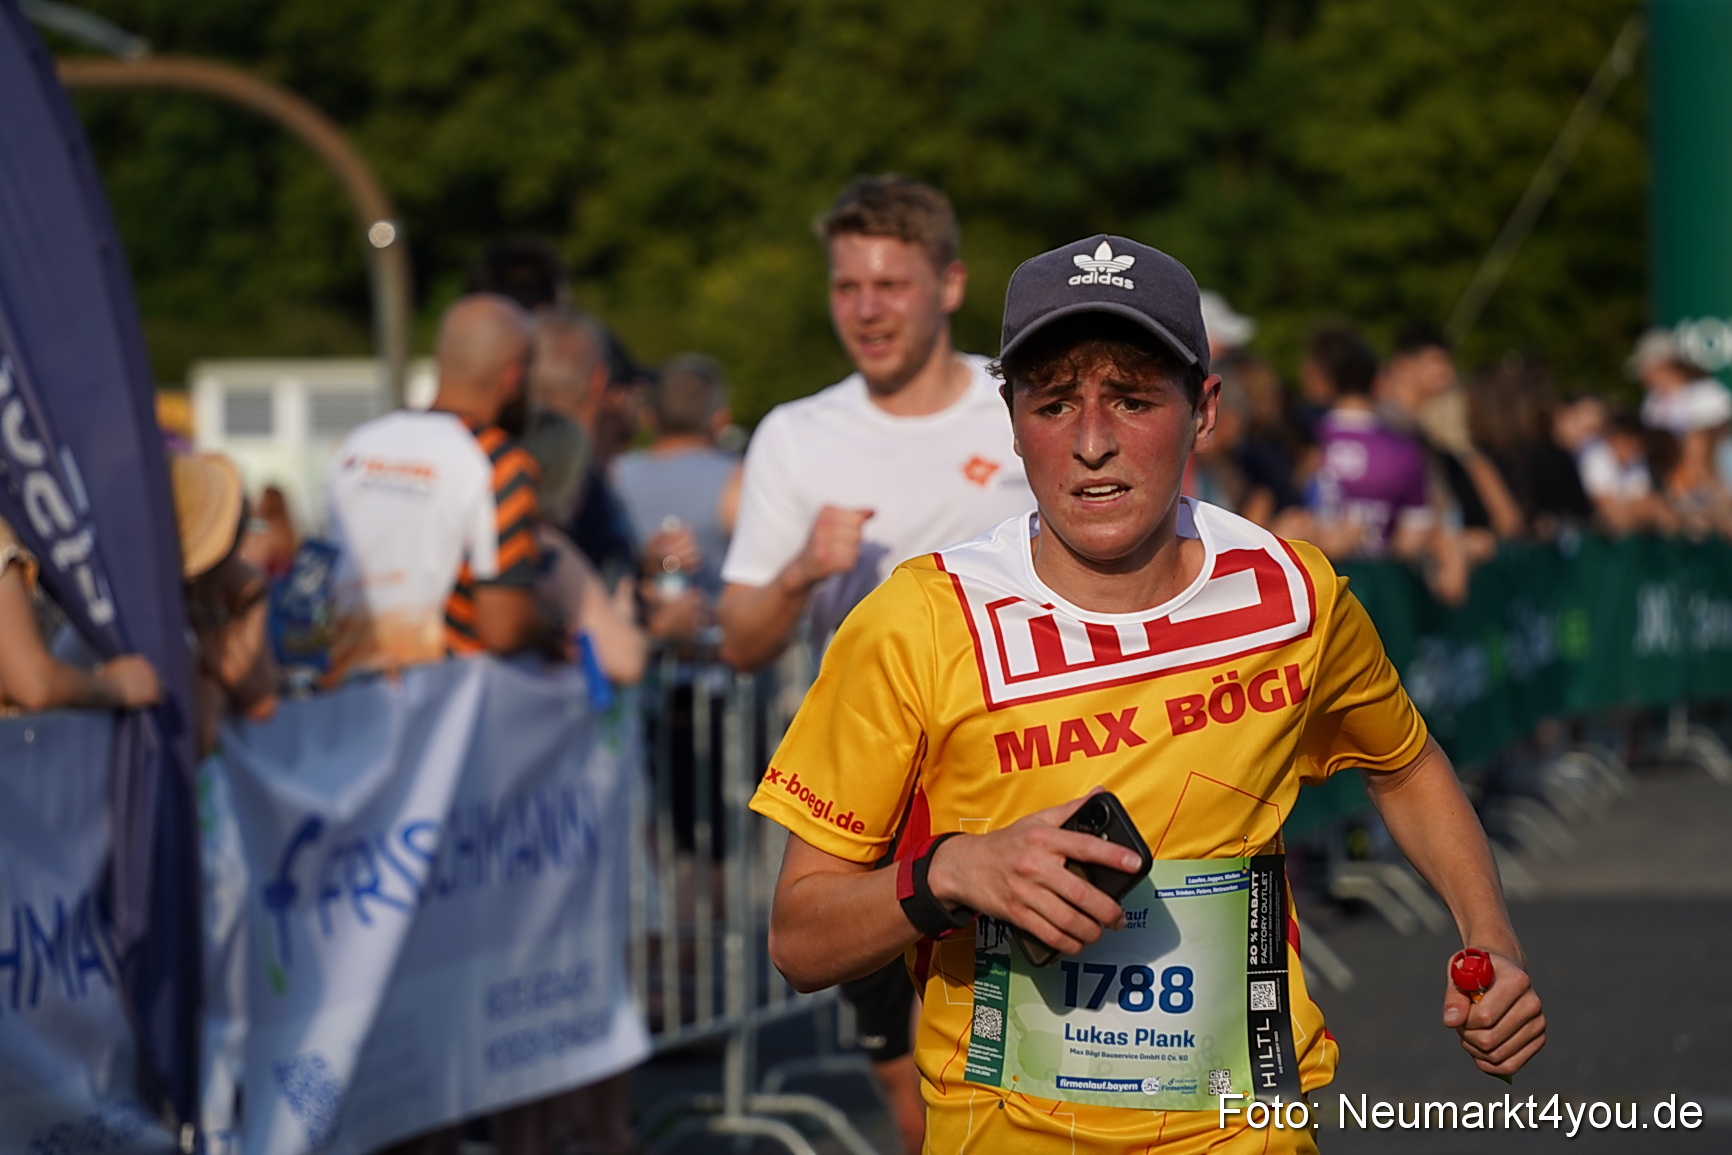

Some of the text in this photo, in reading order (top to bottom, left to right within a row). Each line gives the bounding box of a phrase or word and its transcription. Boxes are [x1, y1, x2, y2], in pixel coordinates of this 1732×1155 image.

[1068, 271, 1135, 290] adidas
[994, 663, 1312, 774] MAX BÖGL
[1249, 870, 1259, 966] 20 % RABATT
[1260, 871, 1268, 964] FACTORY OUTLET
[1060, 960, 1194, 1014] 1788
[1064, 1022, 1196, 1048] Lukas Plank
[1069, 1047, 1085, 1056] Max
[1085, 1049, 1101, 1059] Bögl
[1101, 1050, 1139, 1060] Bauservice
[1139, 1053, 1160, 1061] GmbH
[1256, 1017, 1277, 1088] HILTL
[1059, 1078, 1139, 1092] firmenlauf.bayern
